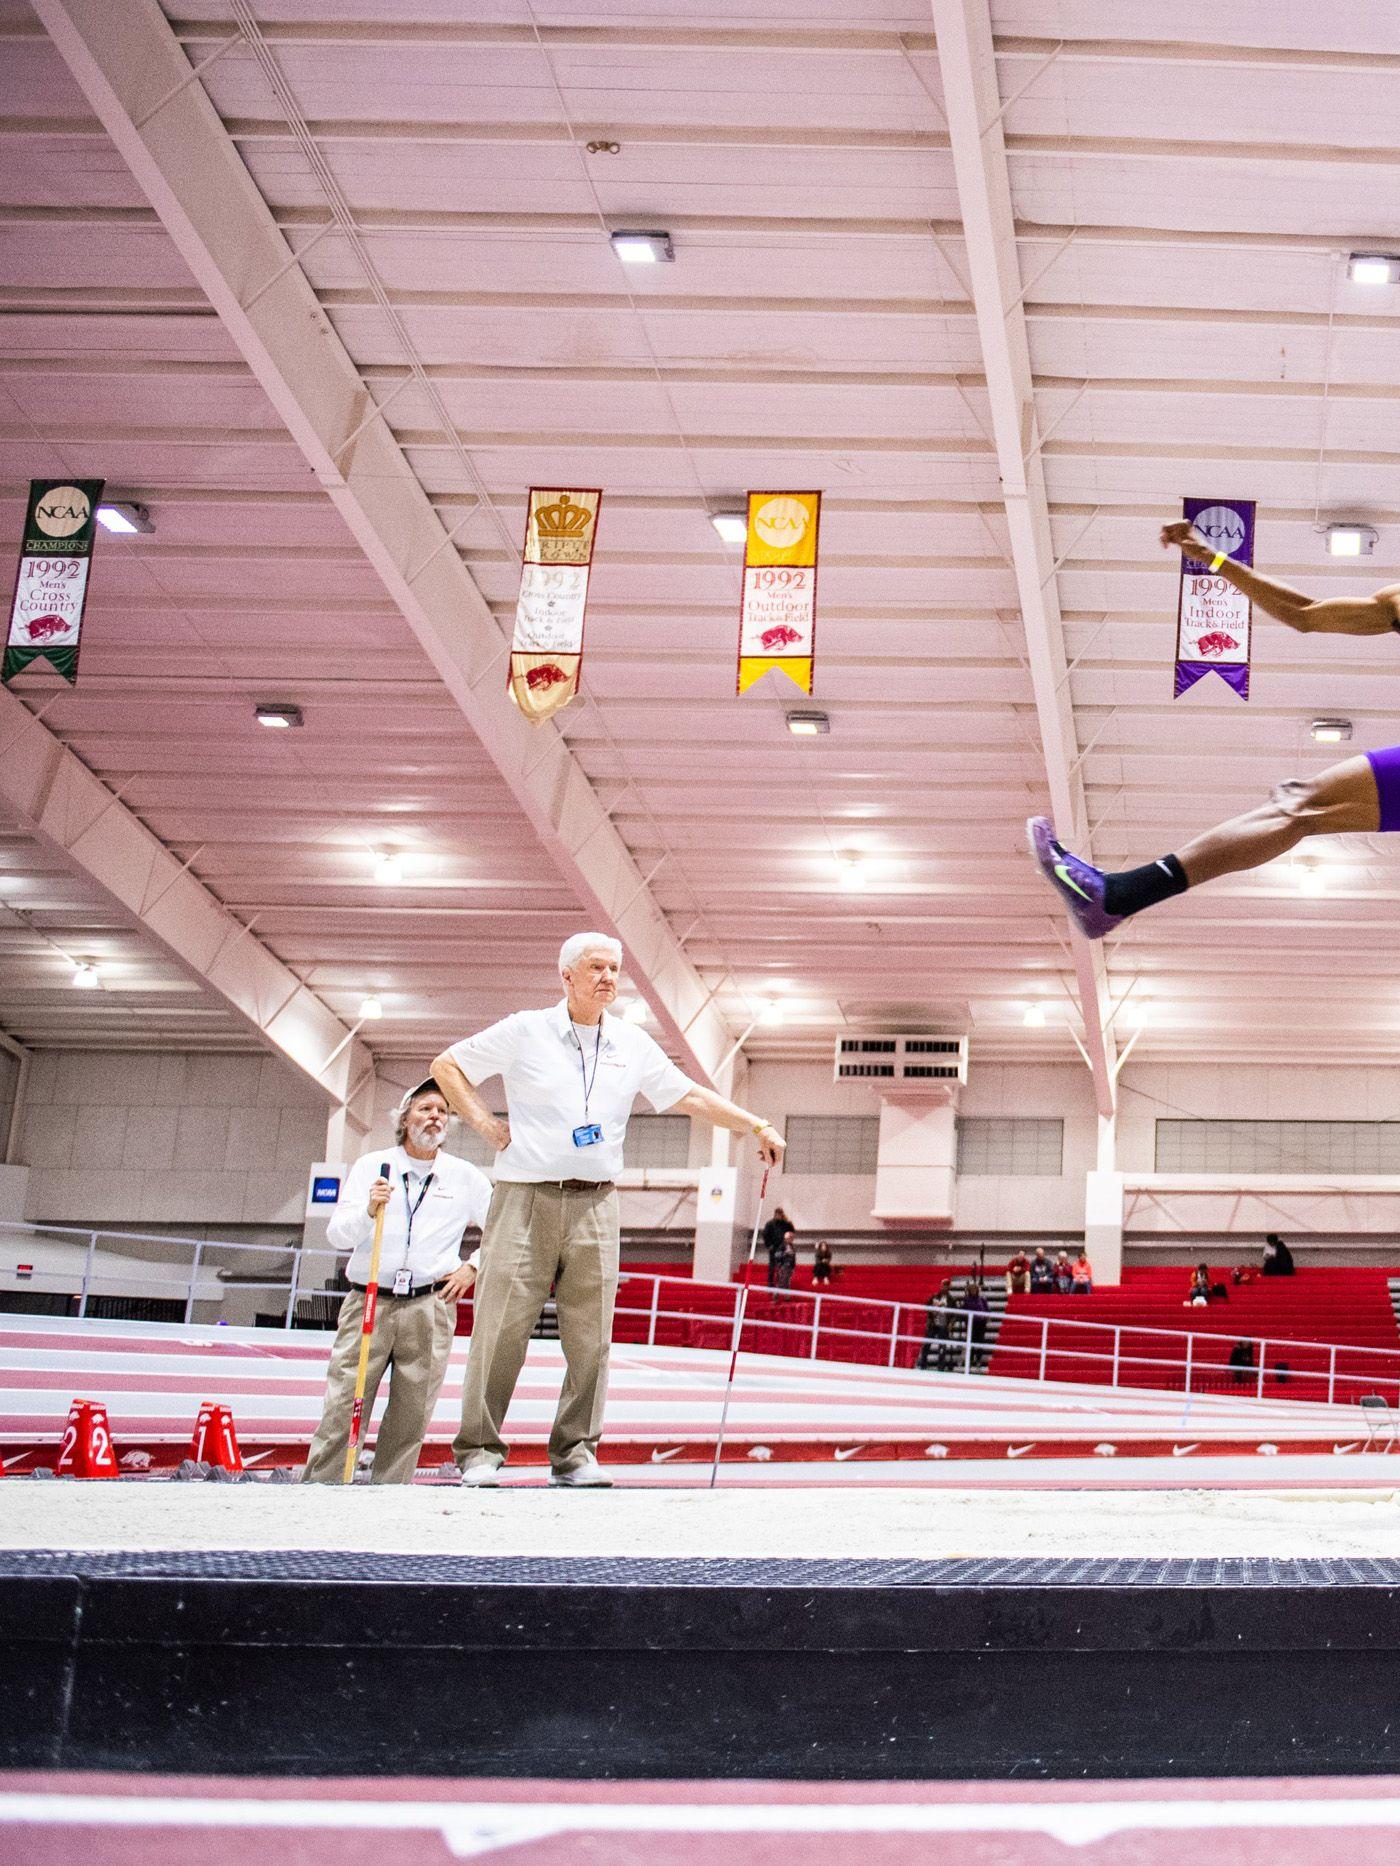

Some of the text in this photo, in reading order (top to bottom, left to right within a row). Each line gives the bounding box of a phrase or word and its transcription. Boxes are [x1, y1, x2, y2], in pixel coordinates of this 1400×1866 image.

[37, 506, 89, 519] NCAA
[757, 518, 809, 529] NCAA
[1193, 525, 1244, 538] NCAA
[27, 560, 80, 579] 1992
[40, 581, 66, 589] Men's
[754, 571, 806, 590] 1992
[30, 590, 70, 601] Cross
[1203, 598, 1228, 606] Men's
[20, 601, 78, 613] Country
[748, 600, 809, 611] Outdoor
[1190, 606, 1241, 619] Indoor
[316, 1188, 337, 1197] NCAA
[60, 1425, 77, 1465] 2
[92, 1426, 112, 1466] 2
[197, 1425, 207, 1463] 1
[223, 1428, 236, 1465] 1
